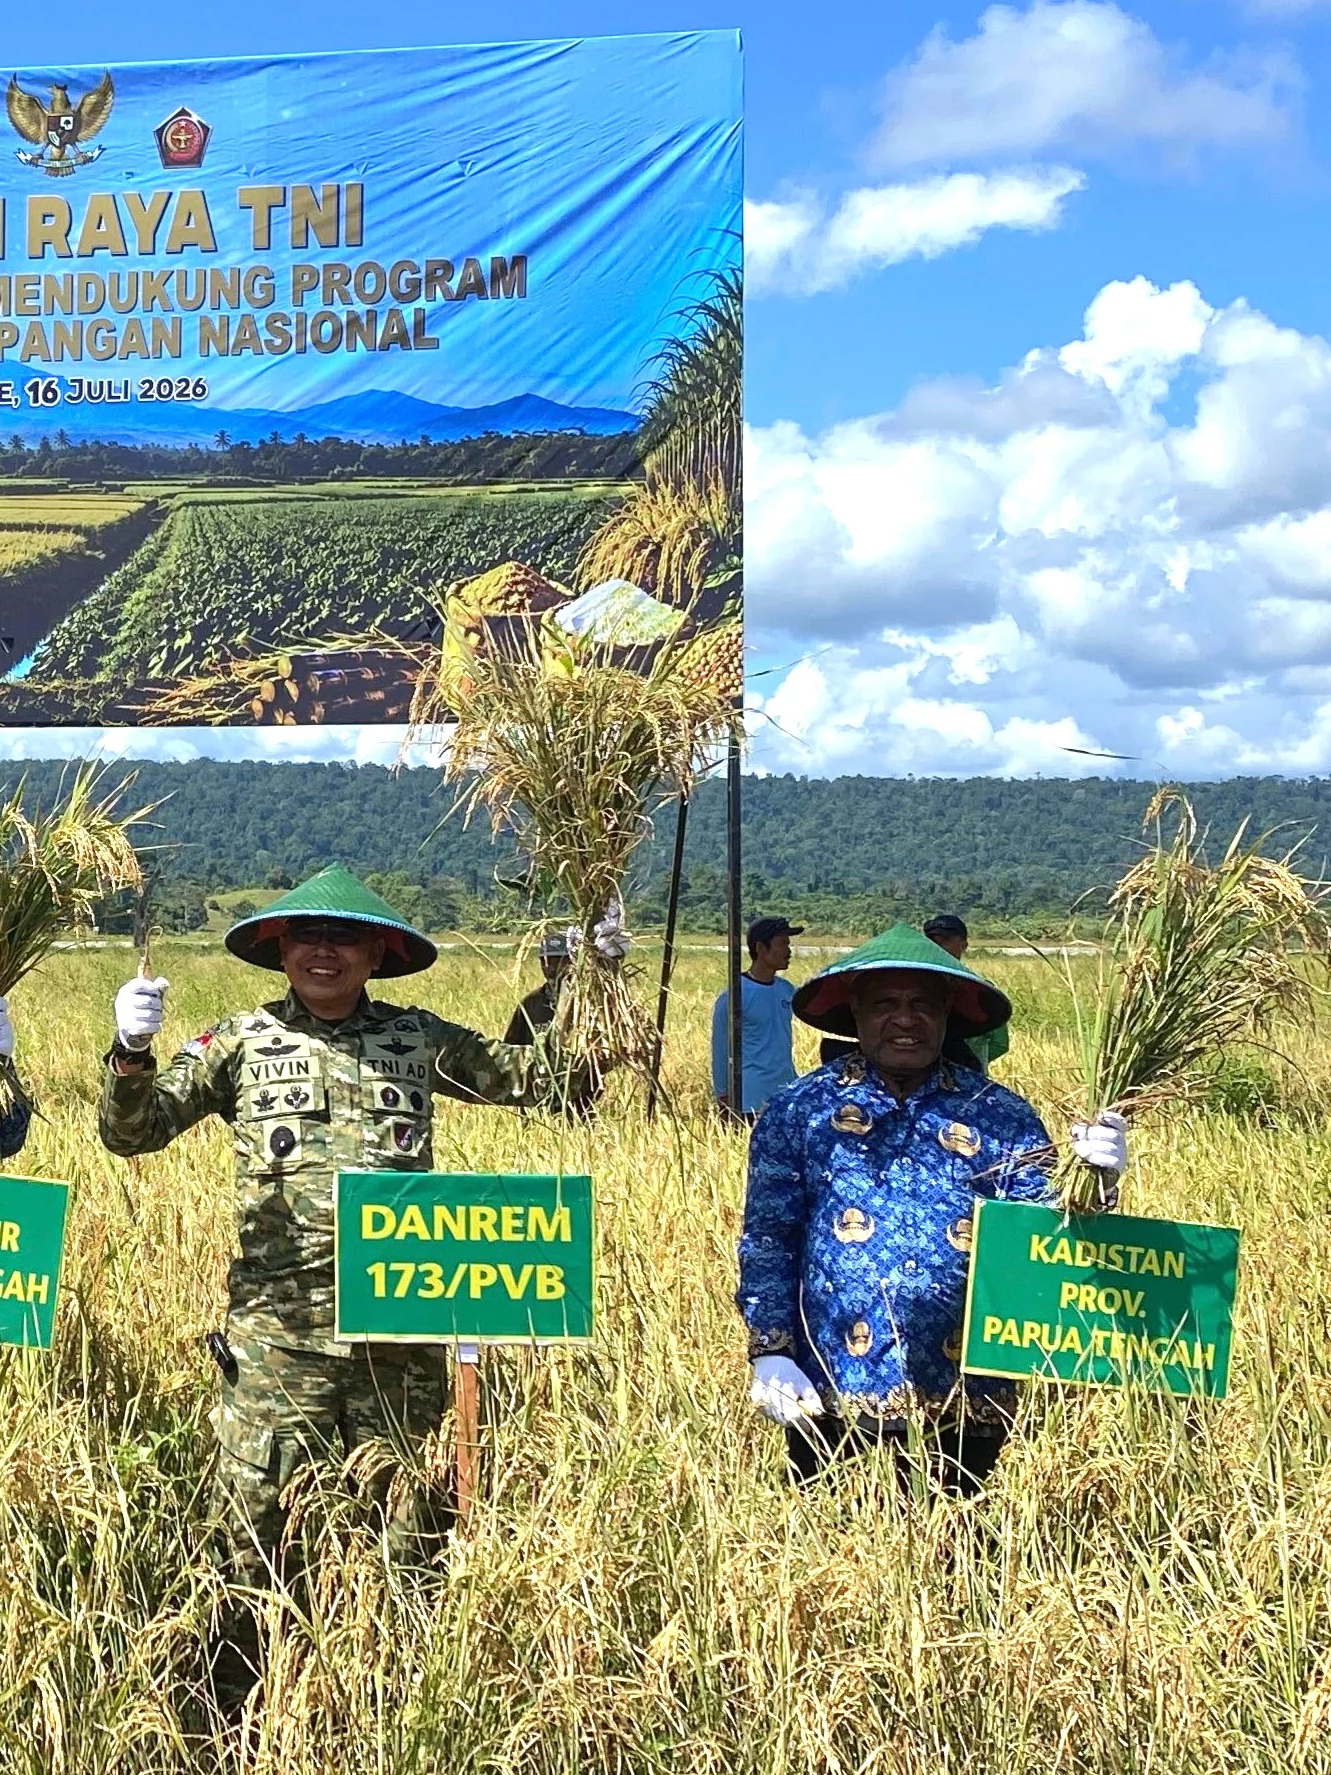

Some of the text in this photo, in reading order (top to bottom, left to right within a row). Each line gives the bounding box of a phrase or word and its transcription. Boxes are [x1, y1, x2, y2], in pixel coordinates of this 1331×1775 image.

[27, 189, 218, 259] RAYA
[238, 182, 364, 251] TNI
[292, 254, 528, 307] PROGRAM
[199, 308, 440, 356] NASIONAL
[27, 378, 59, 407] 16
[66, 379, 130, 402] JULI
[139, 377, 207, 401] 2026
[250, 1060, 310, 1082] VIVIN
[367, 1059, 426, 1079] TNI AD
[361, 1204, 572, 1242] DANREM
[1029, 1234, 1185, 1279] KADISTAN
[366, 1262, 566, 1300] 173/PVB
[1060, 1281, 1147, 1318] PROV.
[983, 1316, 1082, 1354] PAPUA
